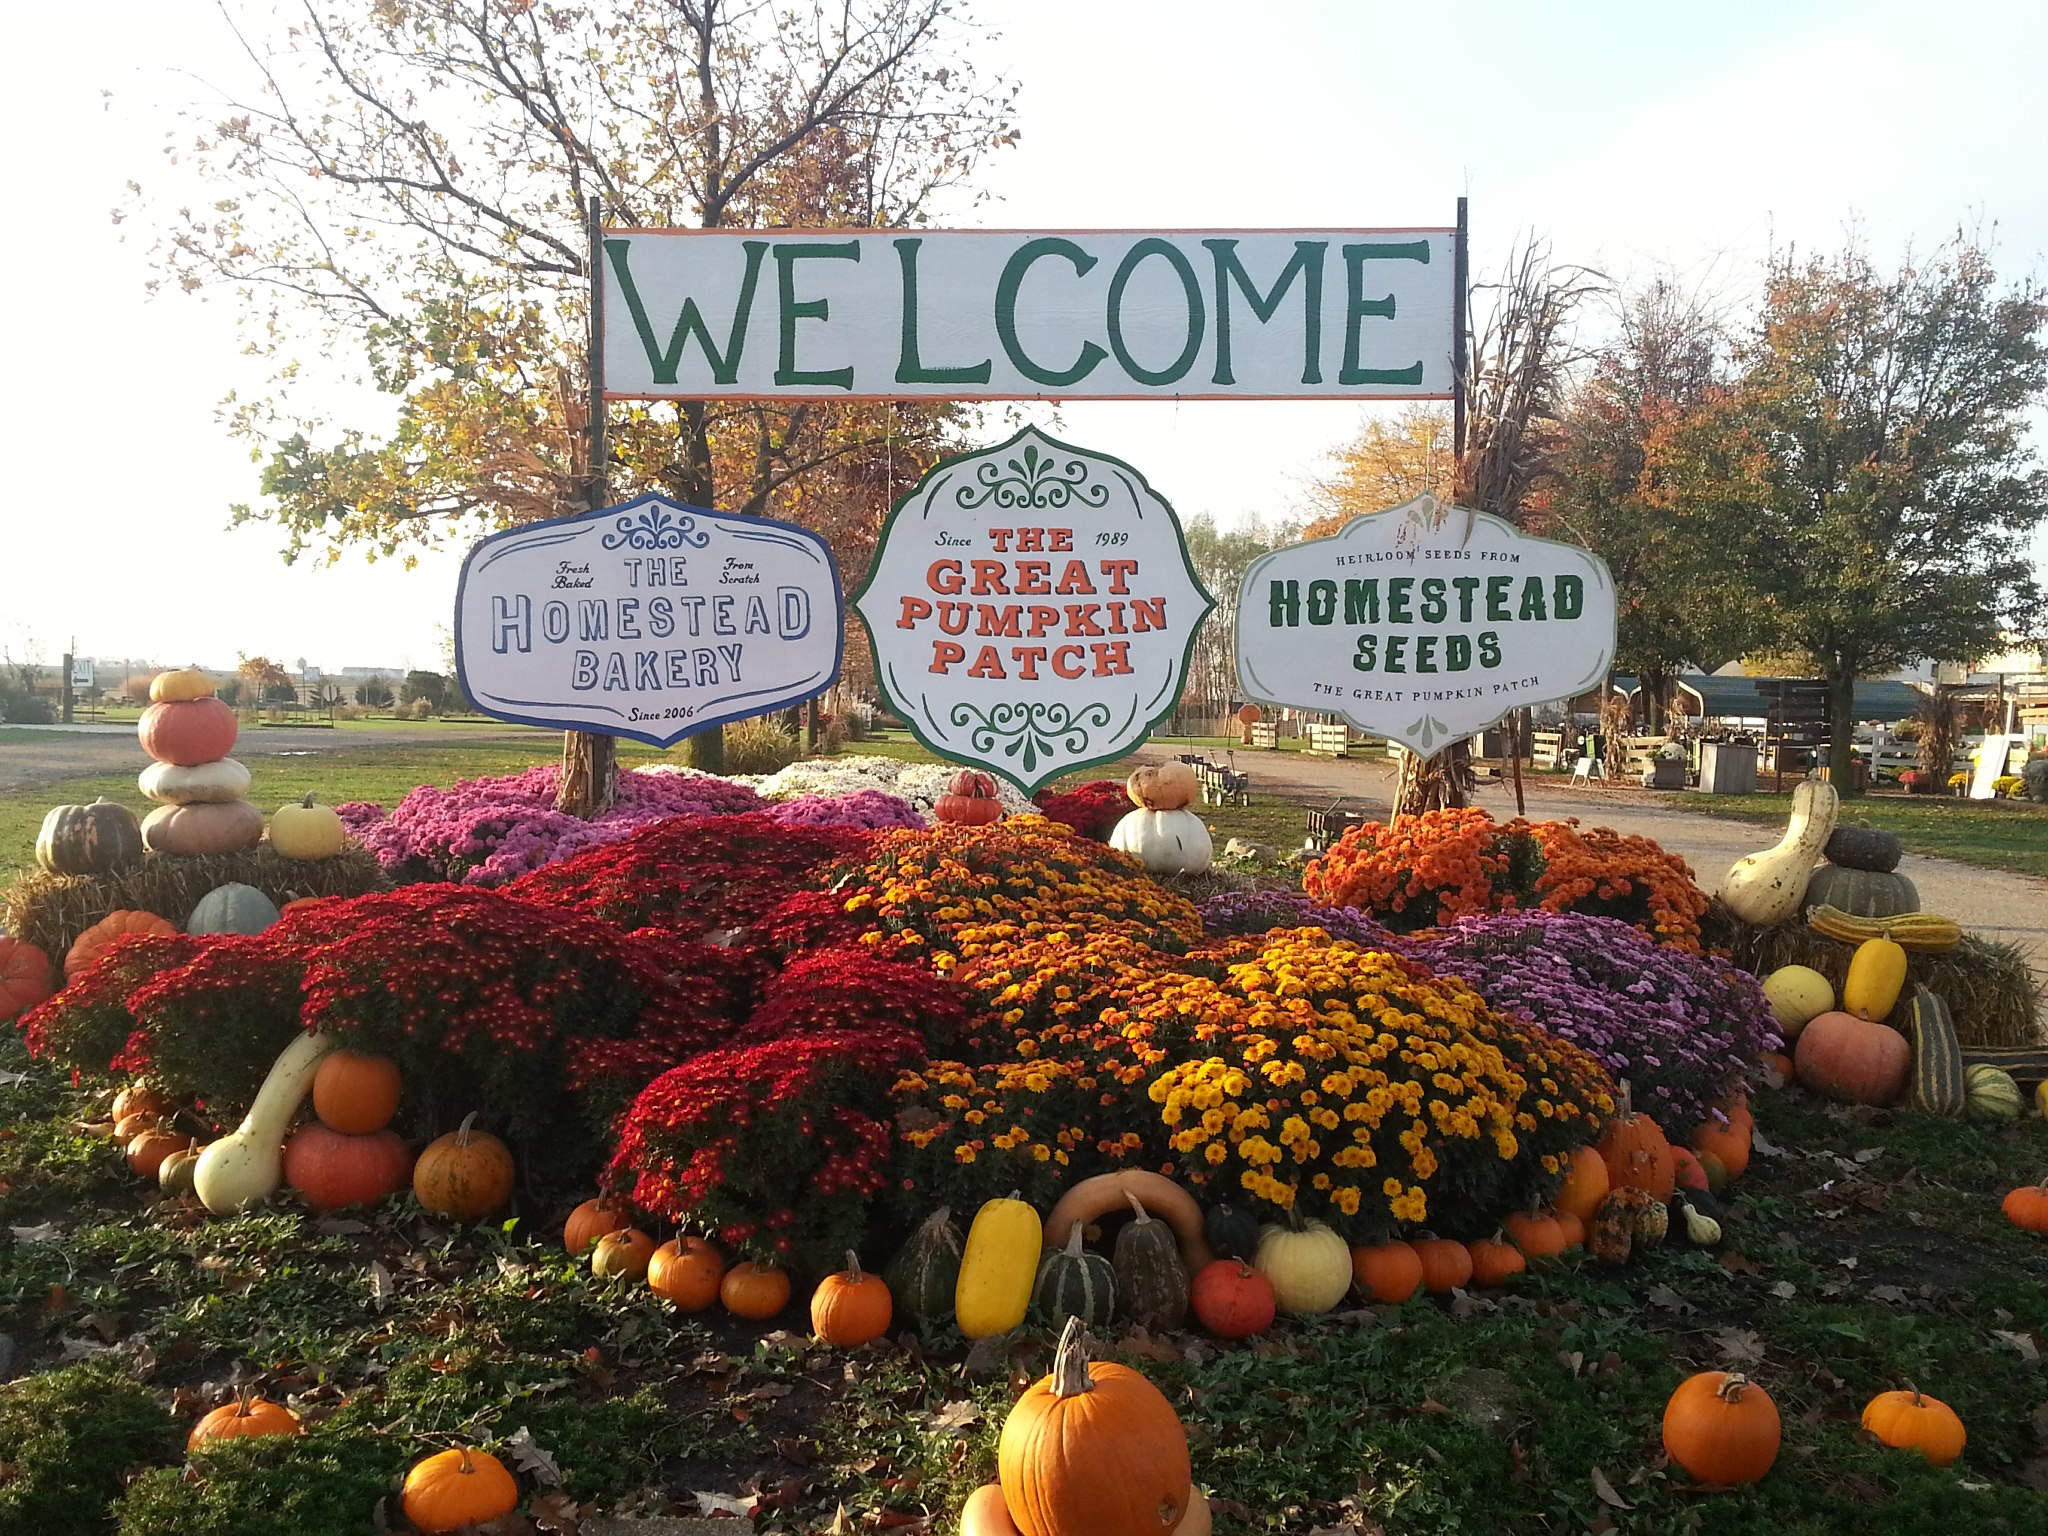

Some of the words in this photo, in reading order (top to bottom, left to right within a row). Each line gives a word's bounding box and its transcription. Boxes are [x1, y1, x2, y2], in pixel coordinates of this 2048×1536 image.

[603, 238, 1430, 390] WELCOME
[934, 531, 972, 547] Since
[988, 527, 1074, 552] THE
[1095, 532, 1129, 547] 1989
[556, 560, 590, 574] Fresh
[723, 557, 754, 571] From
[1336, 550, 1416, 566] HEIRLOOM
[1425, 550, 1471, 560] SEEDS
[1481, 551, 1521, 563] FROM
[551, 575, 594, 589] Baked
[624, 556, 688, 587] THE
[718, 571, 760, 585] Scratch
[926, 559, 1139, 596] GREAT
[1268, 574, 1584, 628] HOMESTEAD
[492, 586, 811, 653] HOMESTEAD
[896, 596, 1168, 638] PUMPKIN
[928, 640, 1135, 681] PATCH
[1352, 631, 1503, 674] SEEDS
[572, 643, 743, 691] BAKERY
[1313, 682, 1344, 697] THE
[1353, 689, 1403, 702] GREAT
[1412, 686, 1484, 702] PUMPKIN
[1493, 676, 1540, 694] PATCH
[628, 707, 661, 722] Since
[663, 706, 695, 720] 2006
